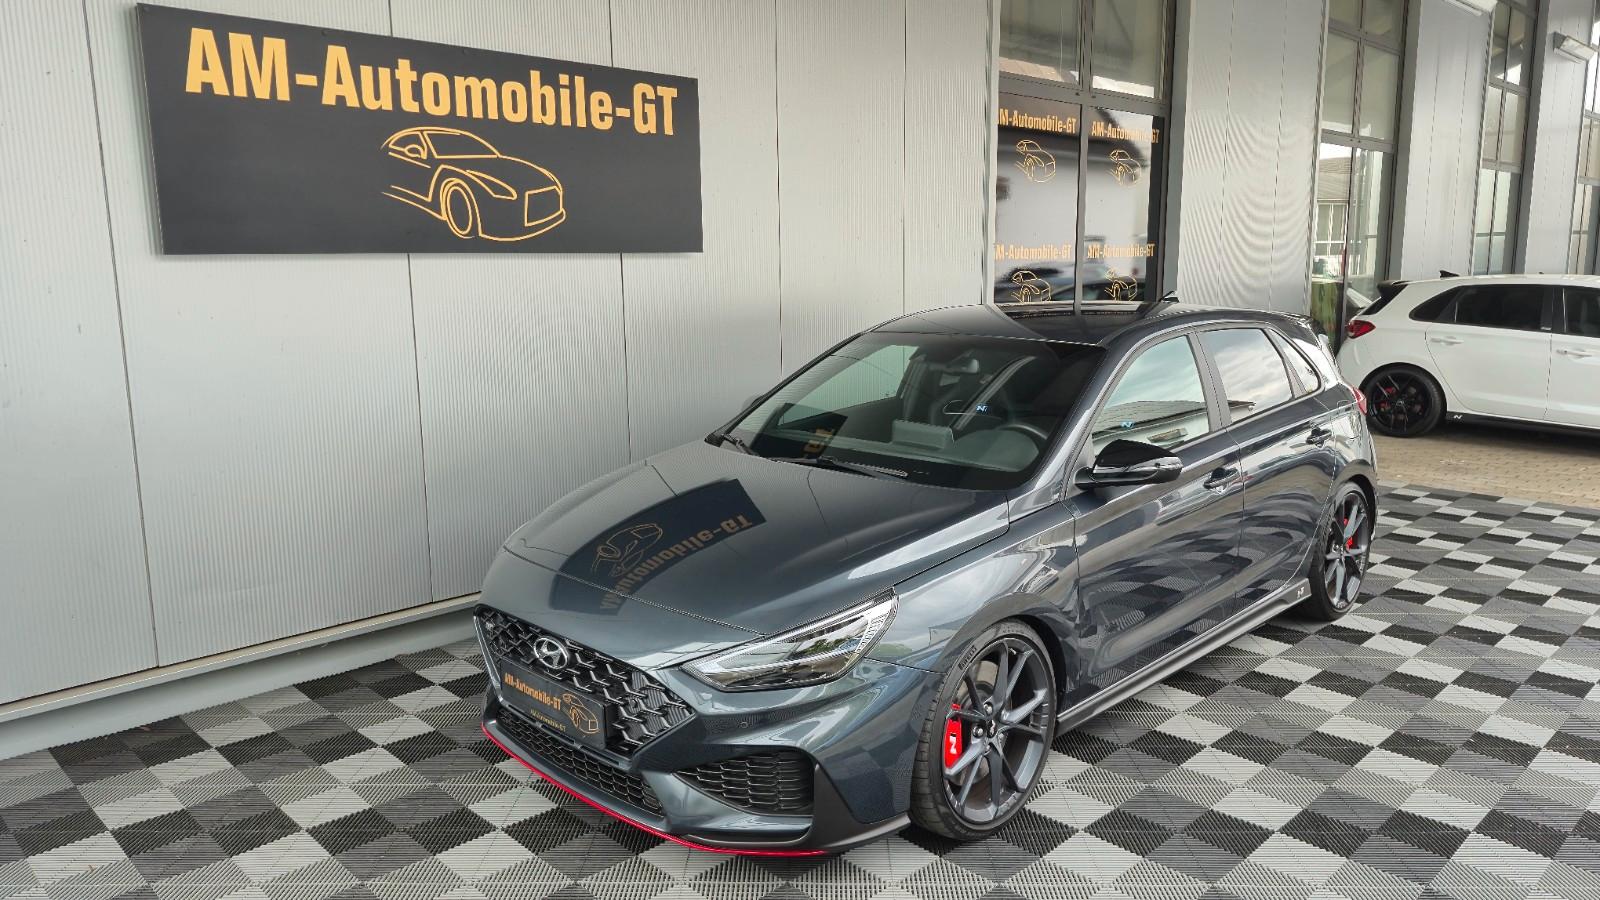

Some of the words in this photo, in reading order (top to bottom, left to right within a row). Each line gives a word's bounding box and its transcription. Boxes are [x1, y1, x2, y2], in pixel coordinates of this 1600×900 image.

[185, 27, 678, 136] AM-Automobile-GT
[998, 108, 1077, 134] M-Automobile-GT
[995, 243, 1073, 262] M-Automobile-GT
